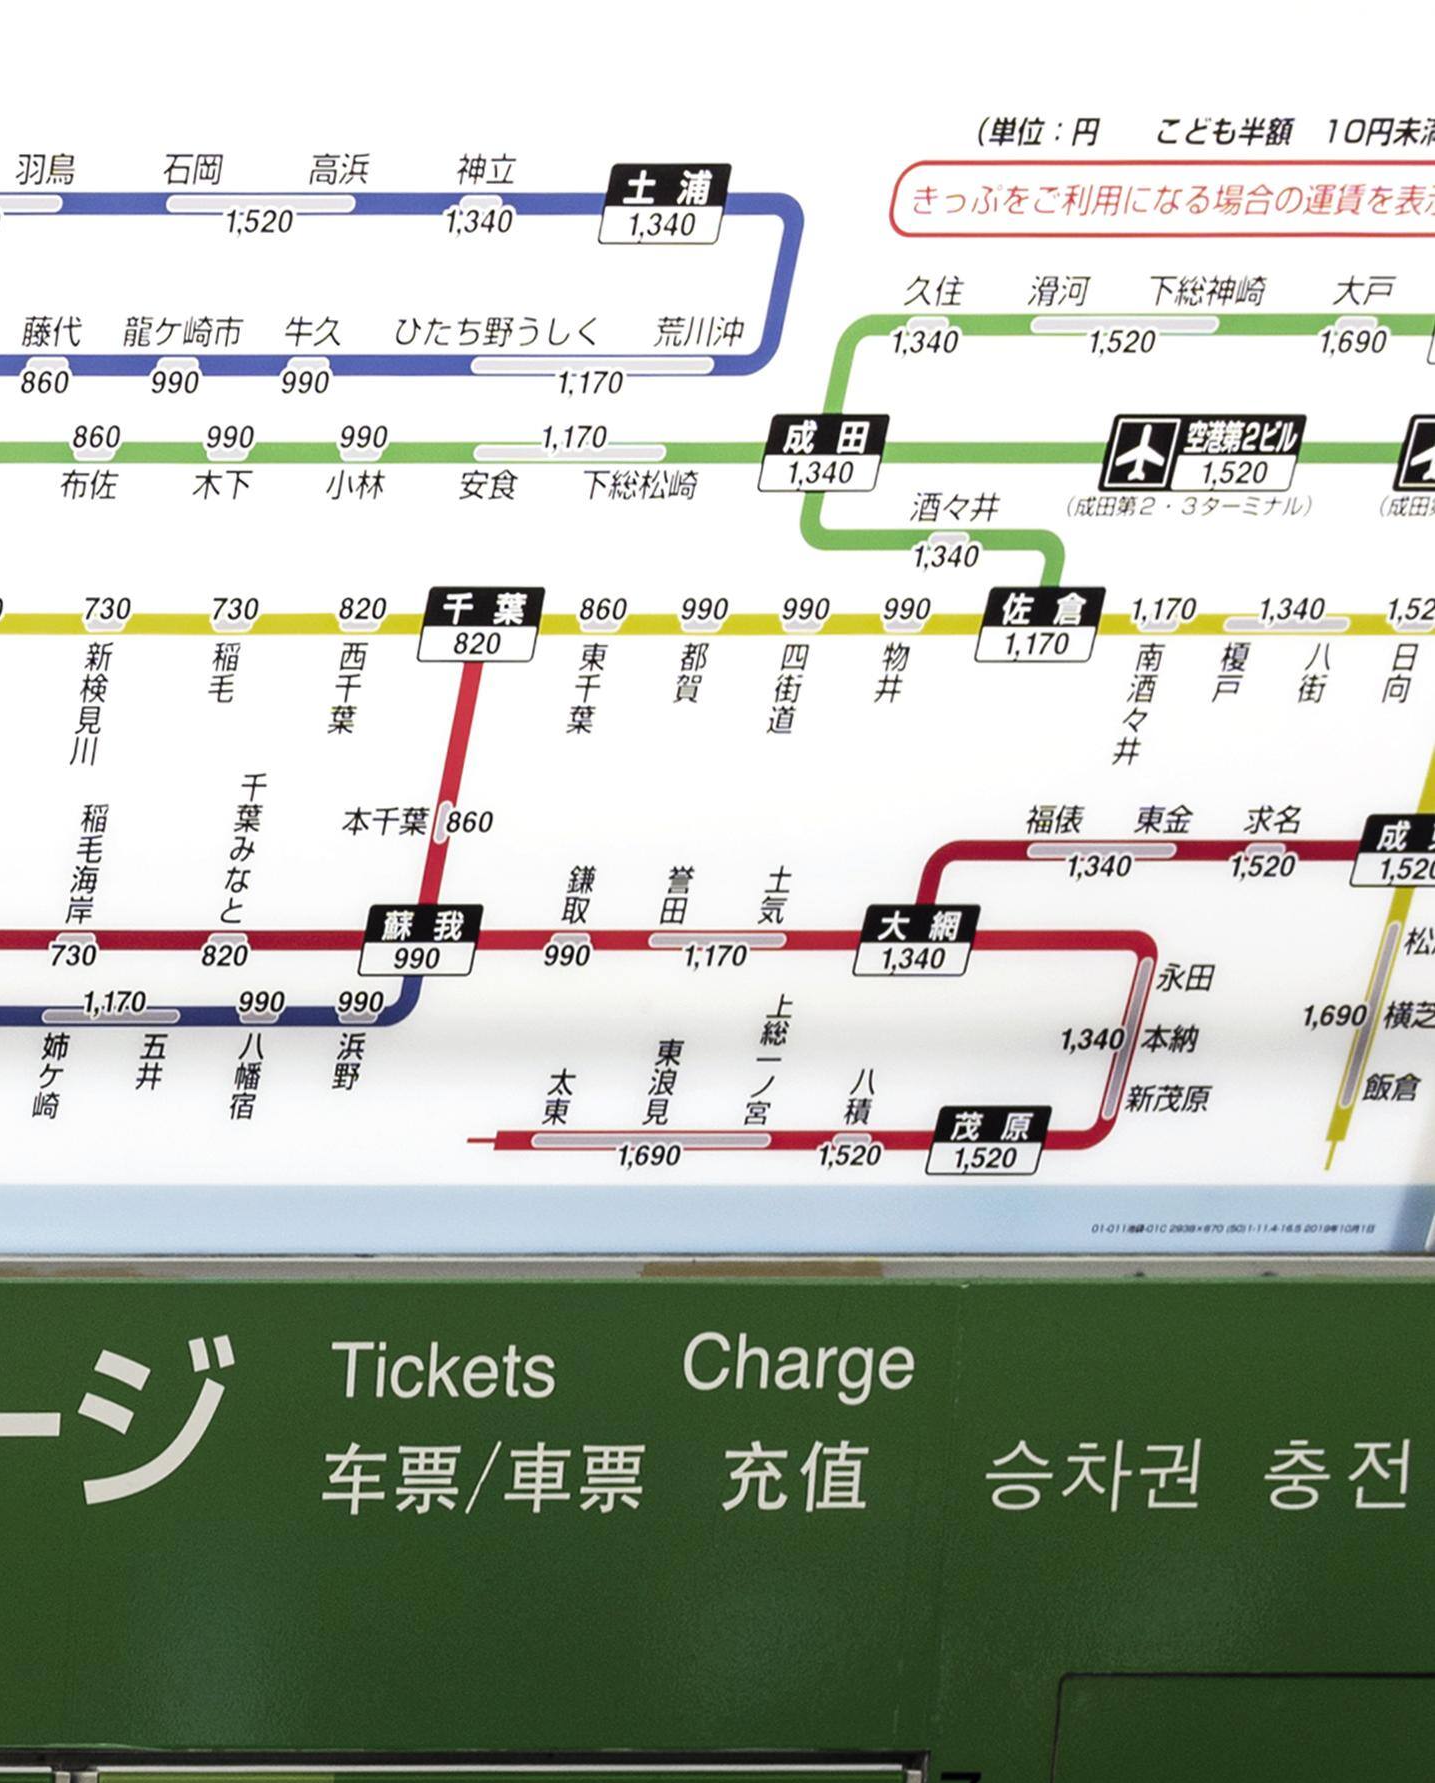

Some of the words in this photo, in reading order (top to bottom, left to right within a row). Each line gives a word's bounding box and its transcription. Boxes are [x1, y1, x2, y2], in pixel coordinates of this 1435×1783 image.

[1157, 116, 1295, 146] こども半額
[1150, 276, 1266, 307] 下総神崎
[654, 316, 745, 347] 荒川沖
[151, 370, 199, 394] 990
[1184, 419, 1299, 454] 空港第2ビル
[910, 492, 1000, 522] 酒々井
[220, 773, 267, 924] 千葉みなと
[743, 993, 793, 1126] 上総一ノ宮
[1125, 1084, 1213, 1113] 新茂原
[331, 1341, 555, 1399] Tickets
[683, 1331, 915, 1406] Charge
[721, 1439, 870, 1513] 充值
[985, 1437, 1202, 1513] 승차권
[1263, 1438, 1411, 1510] 충전
